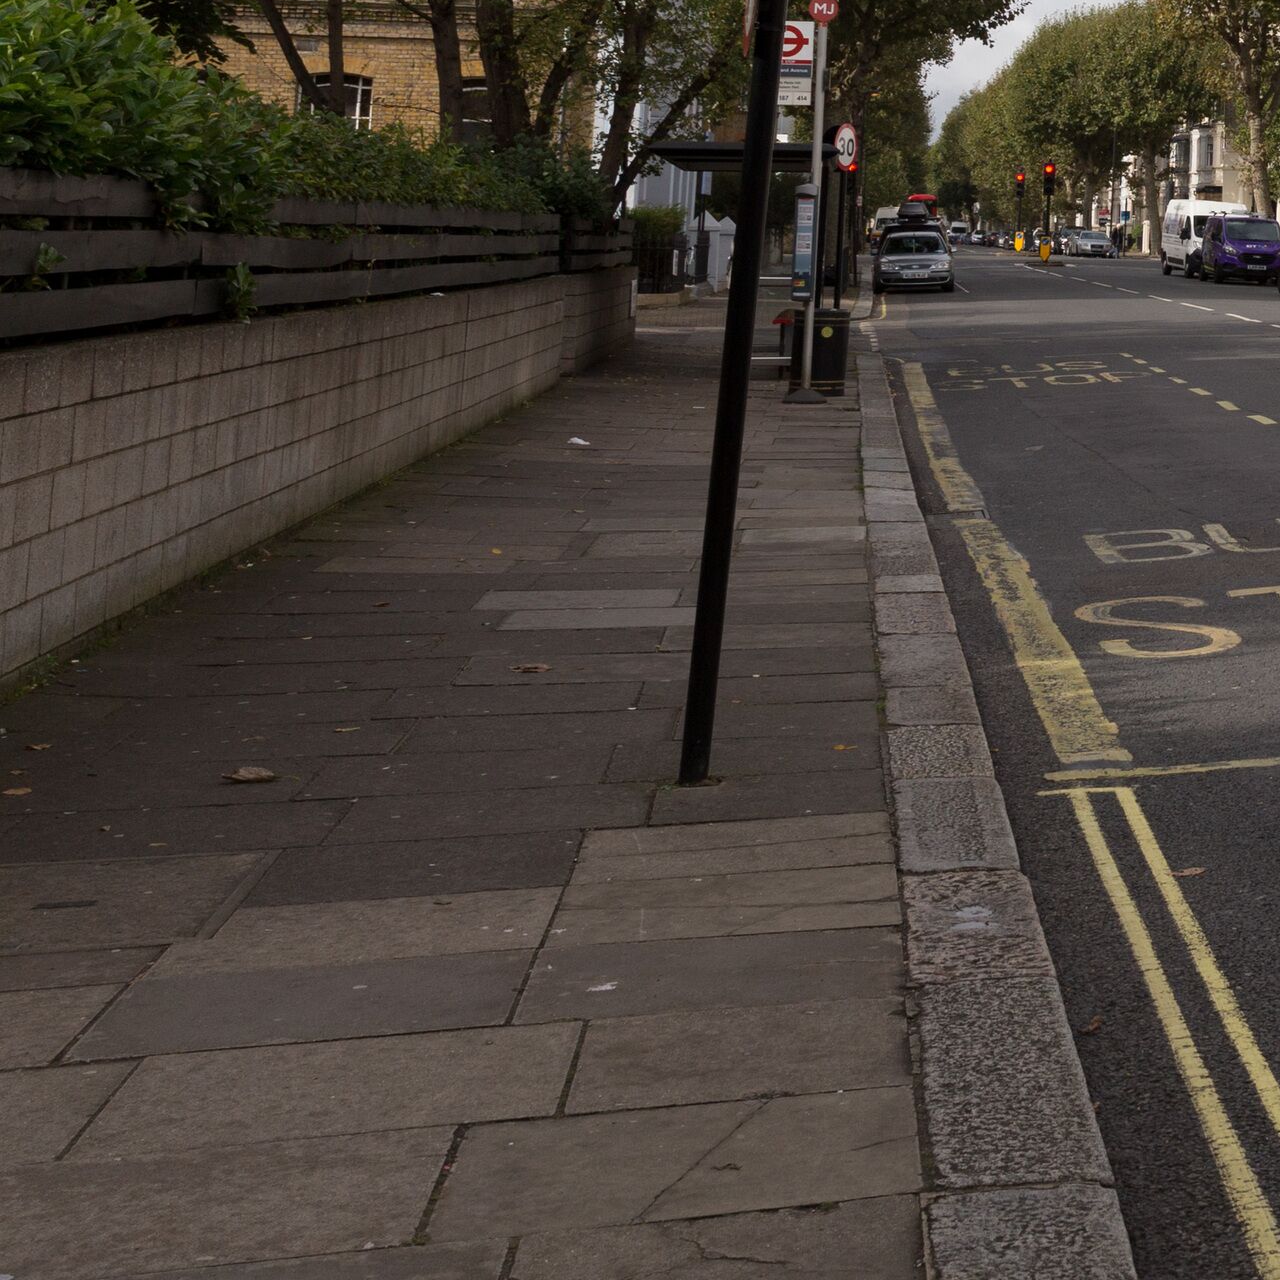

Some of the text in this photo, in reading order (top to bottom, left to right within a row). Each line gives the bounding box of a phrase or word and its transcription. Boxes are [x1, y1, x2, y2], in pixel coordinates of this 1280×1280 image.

[814, 3, 835, 15] MJ
[839, 137, 855, 156] 30
[947, 359, 1108, 377] BUS
[933, 370, 1152, 391] STOP
